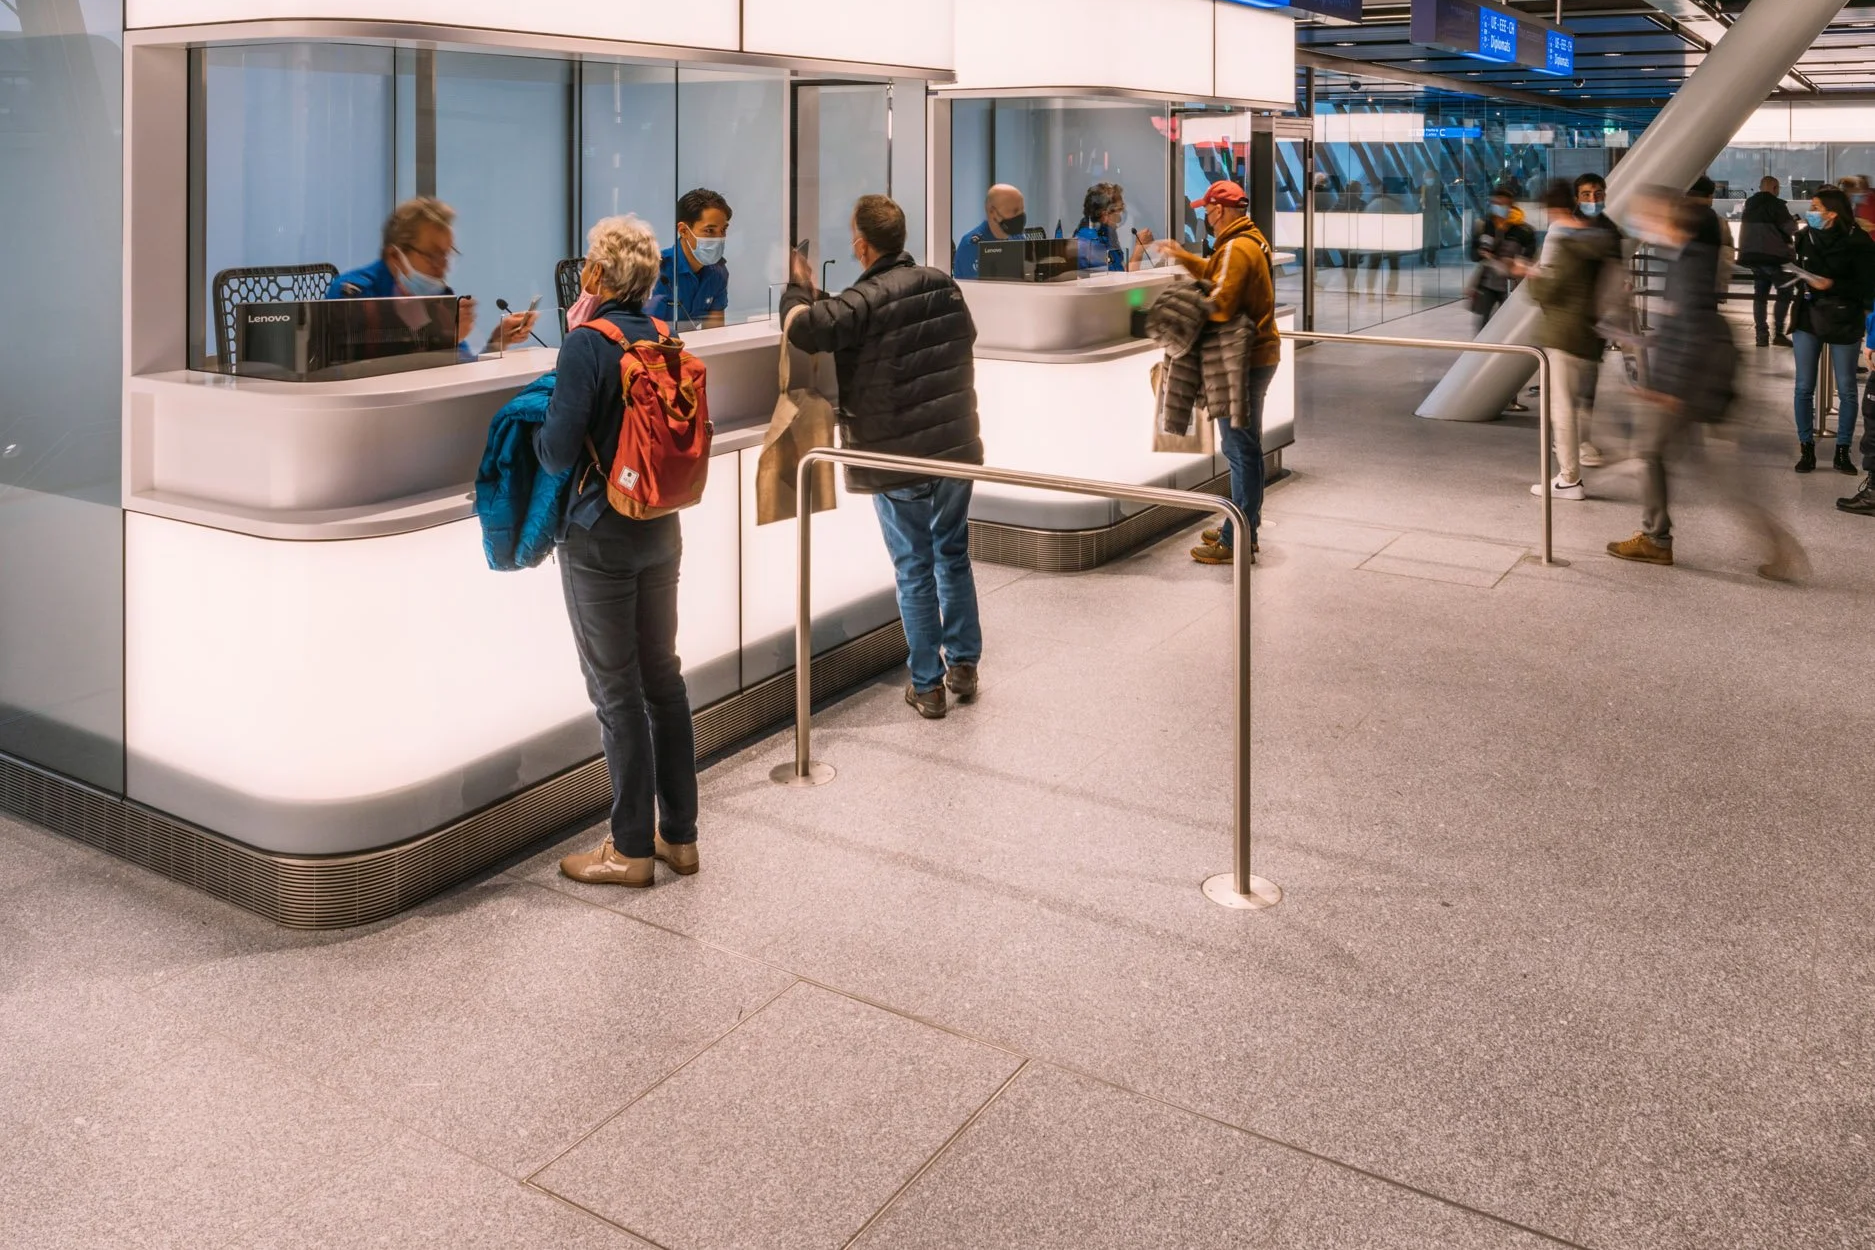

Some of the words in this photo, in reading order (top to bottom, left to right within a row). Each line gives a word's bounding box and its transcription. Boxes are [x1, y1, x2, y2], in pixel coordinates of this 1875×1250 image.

[1490, 15, 1497, 30] UE
[1499, 18, 1507, 33] EEE
[1490, 34, 1511, 53] Diplomats
[1440, 128, 1446, 137] C
[248, 314, 290, 323] Lenovo
